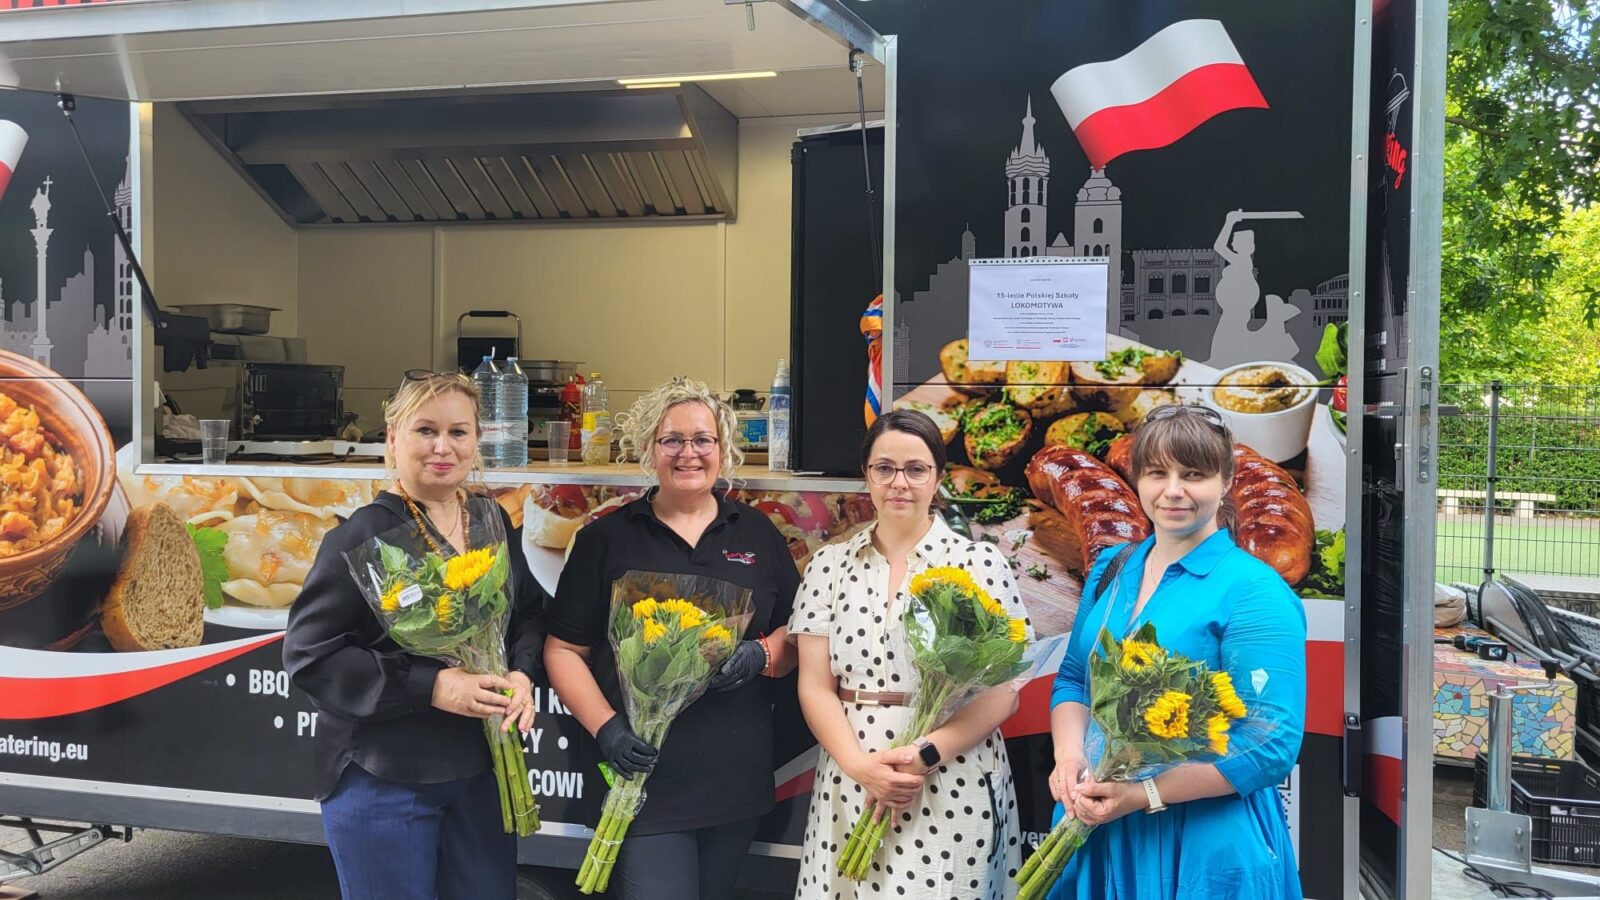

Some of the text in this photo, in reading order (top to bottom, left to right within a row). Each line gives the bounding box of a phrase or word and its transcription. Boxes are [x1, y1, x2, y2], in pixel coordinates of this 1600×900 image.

[1026, 292, 1054, 300] Polskiej
[1055, 292, 1079, 300] Szkoły
[249, 669, 289, 699] BBQ
[548, 688, 572, 715] K
